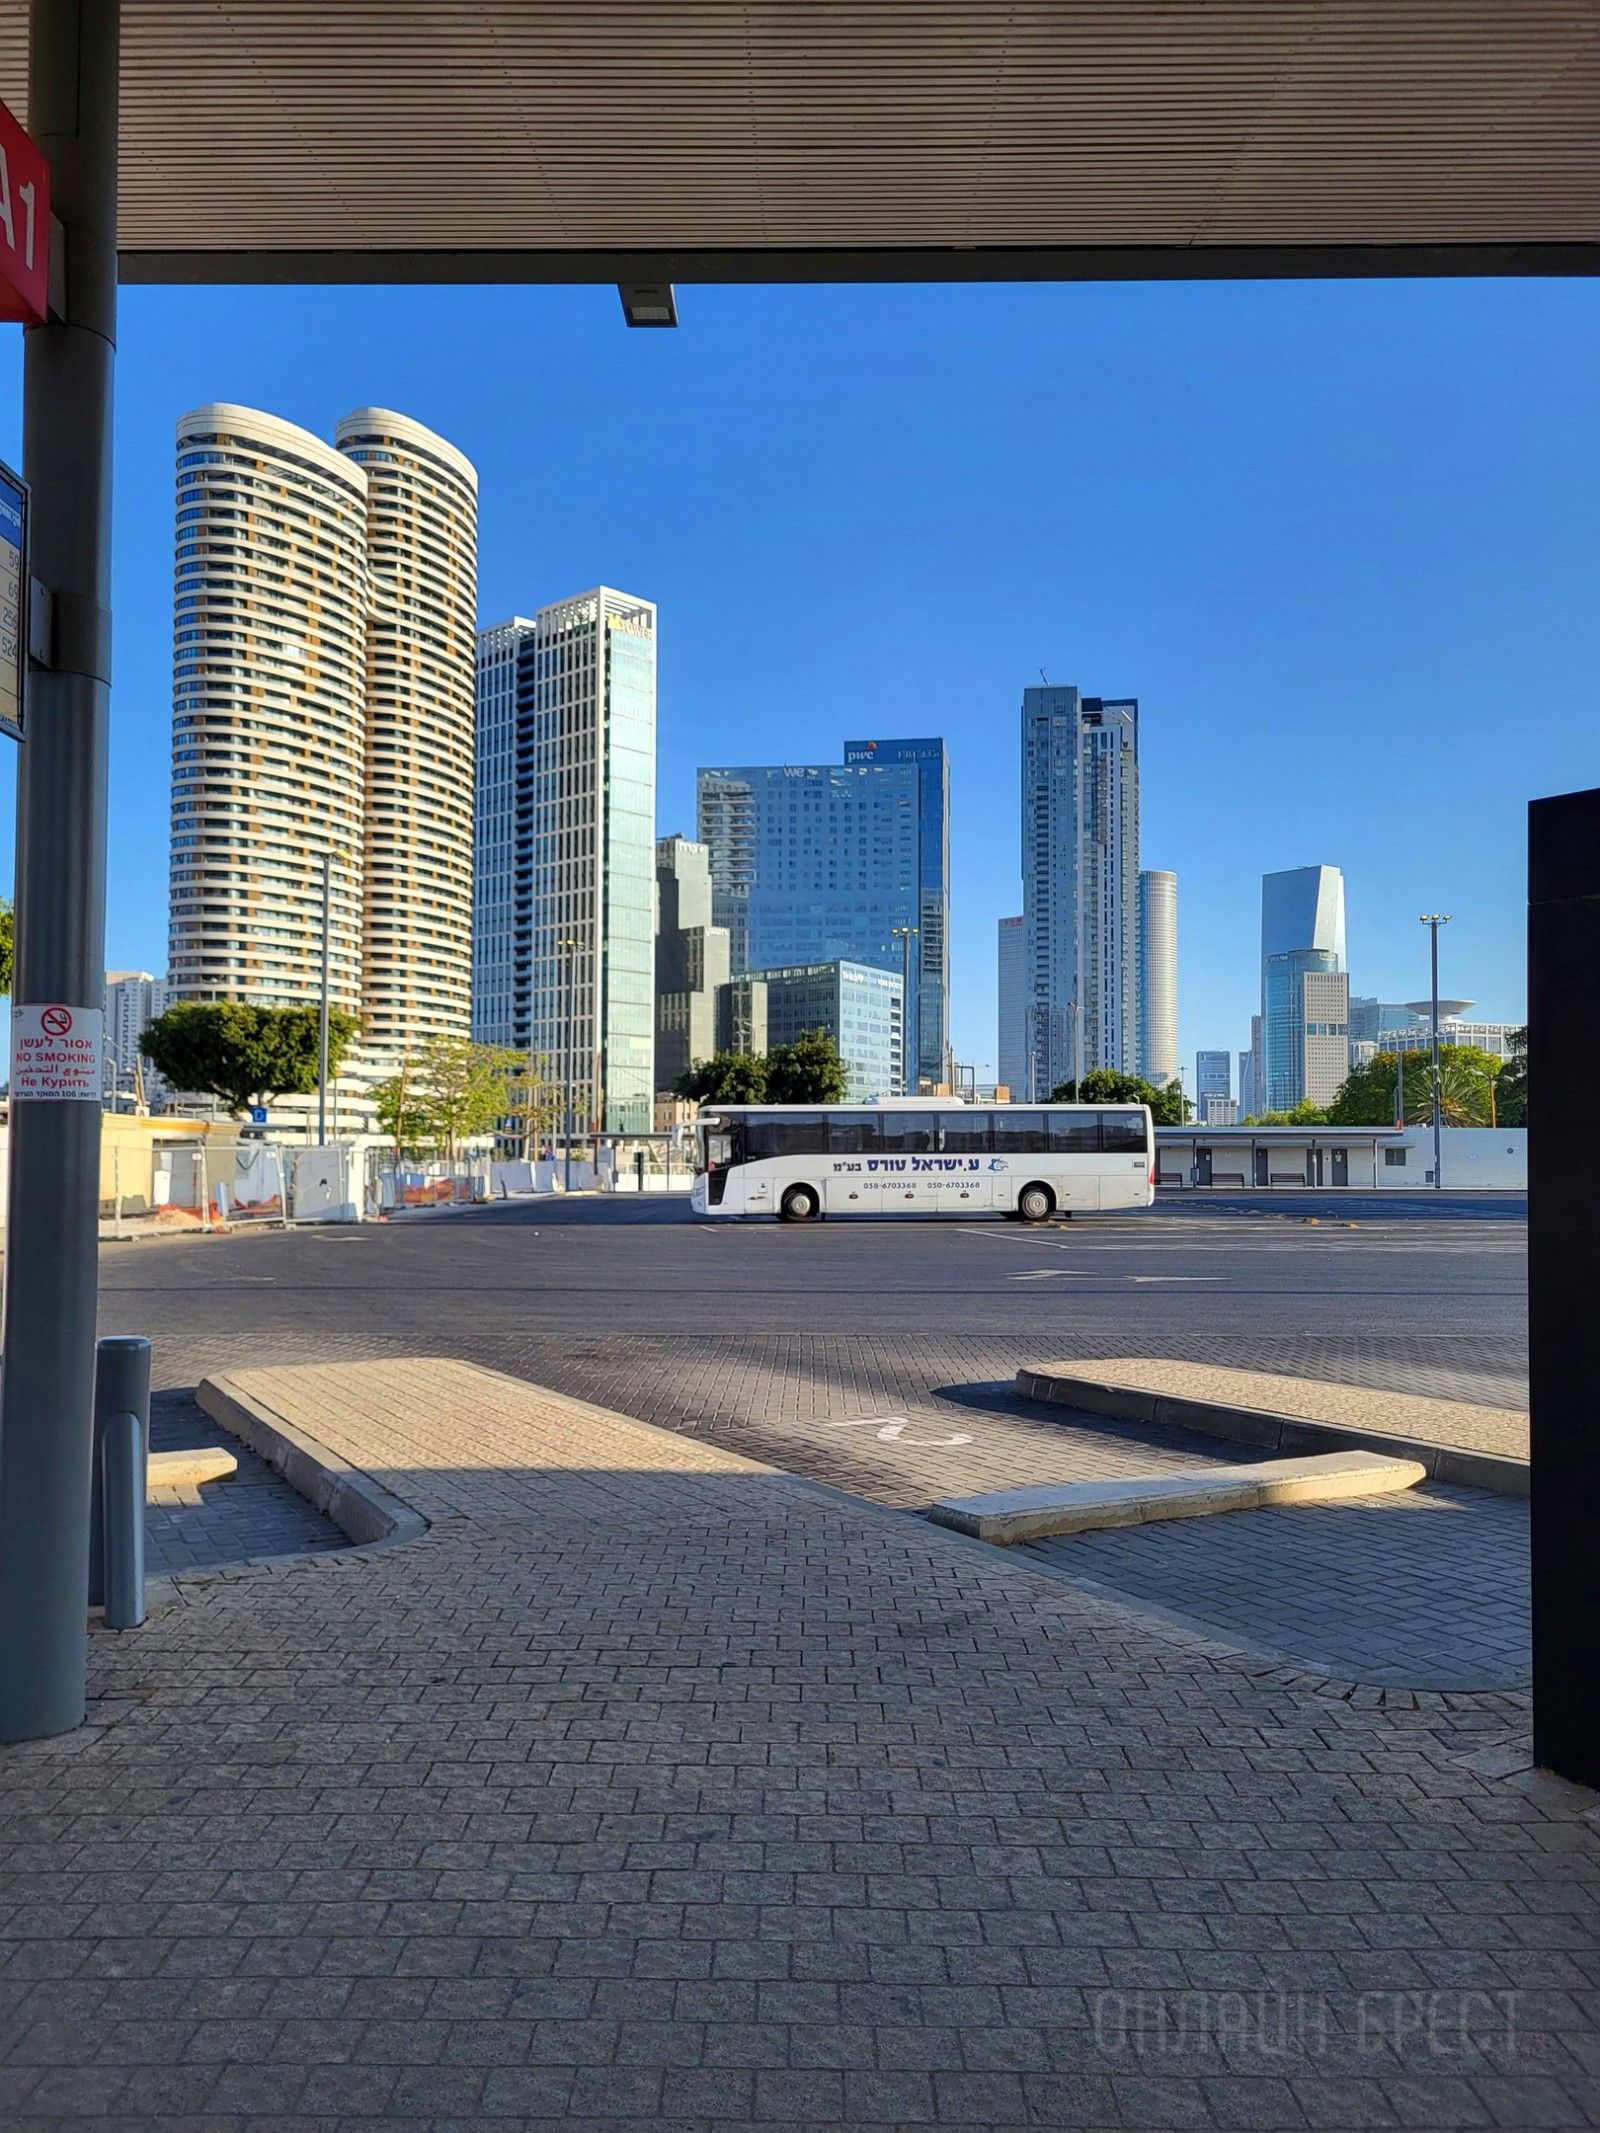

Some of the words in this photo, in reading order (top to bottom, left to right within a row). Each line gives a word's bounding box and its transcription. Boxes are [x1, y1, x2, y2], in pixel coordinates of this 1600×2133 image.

[8, 549, 20, 571] 59
[8, 580, 19, 601] 69
[847, 750, 874, 763] pwc
[20, 1035, 54, 1051] לעשן
[59, 1038, 93, 1049] אסור
[16, 1052, 32, 1063] NO
[35, 1052, 96, 1064] SMOKING
[21, 1076, 37, 1087] Не
[41, 1076, 90, 1089] Курить
[62, 1090, 77, 1098] 106
[832, 1161, 862, 1172] בע"מ
[866, 1158, 907, 1172] טורס
